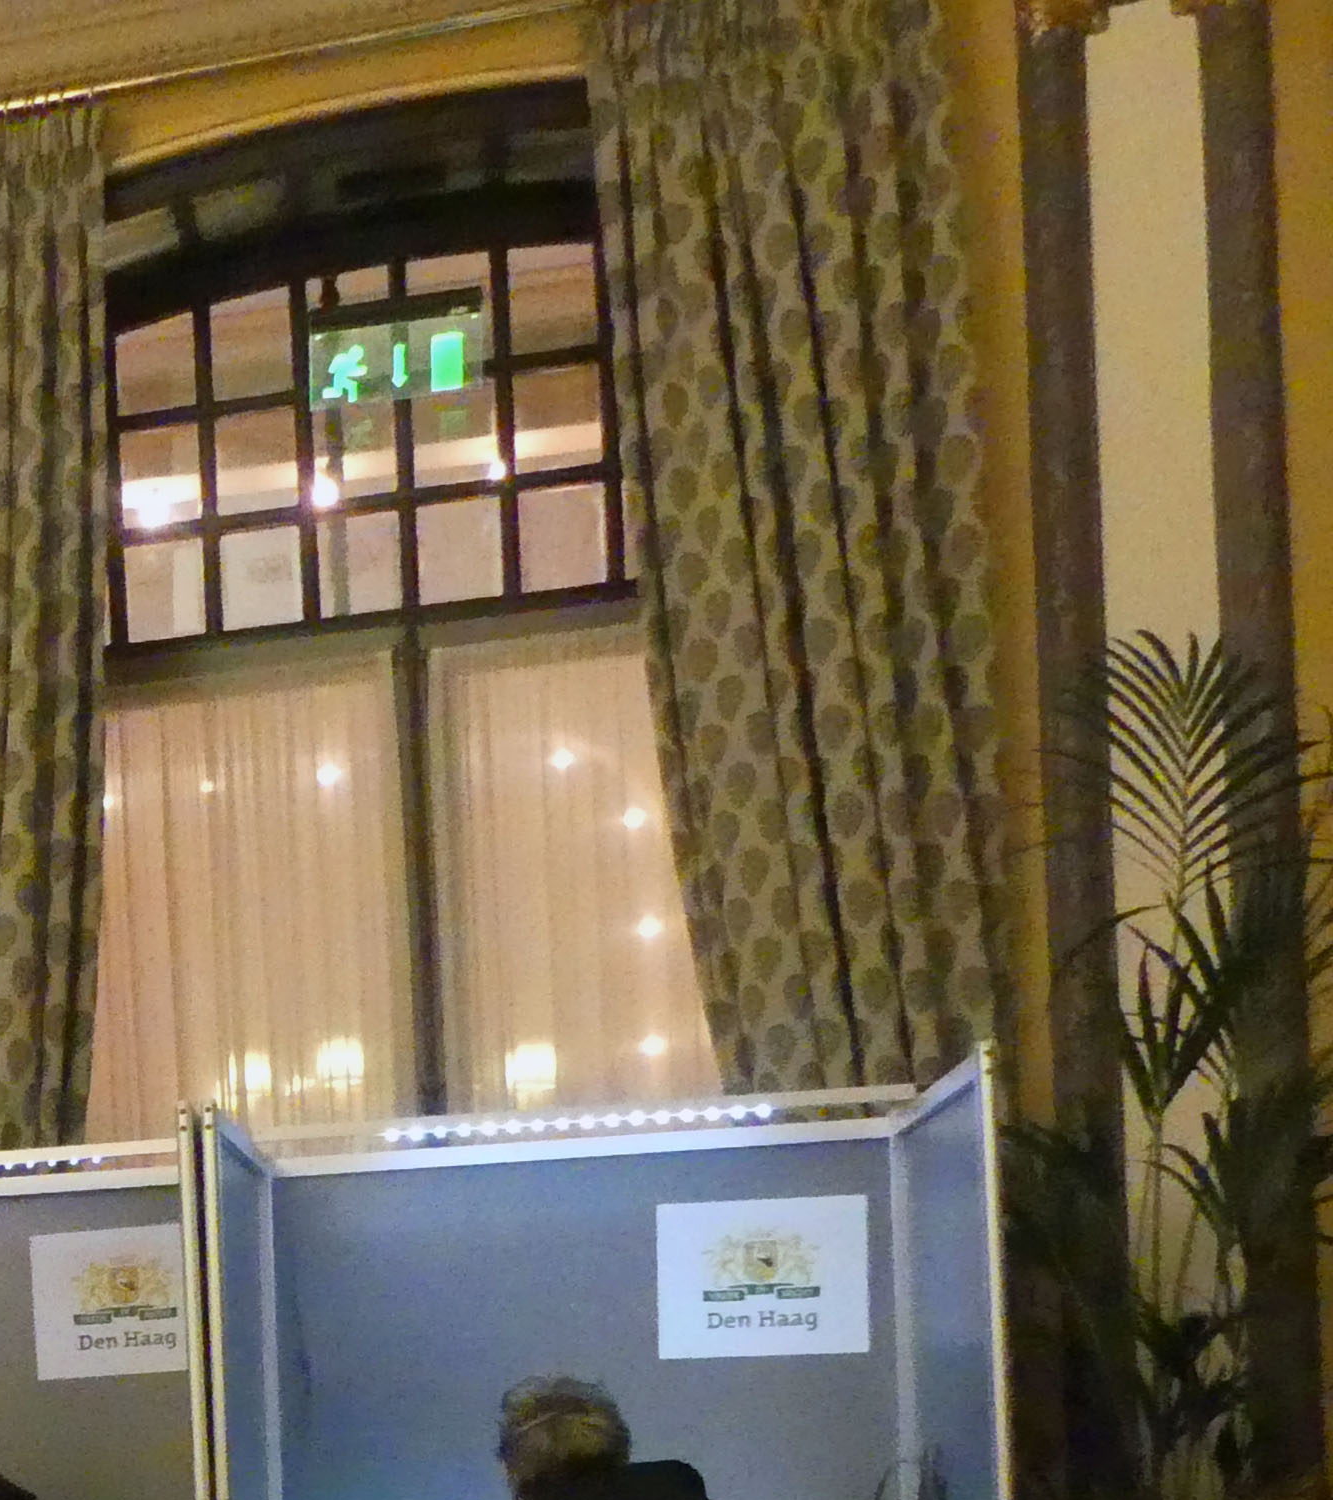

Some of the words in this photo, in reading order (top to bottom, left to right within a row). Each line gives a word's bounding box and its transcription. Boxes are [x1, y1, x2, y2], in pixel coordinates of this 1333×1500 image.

[707, 1312, 751, 1329] Den
[758, 1310, 818, 1331] Haag
[77, 1334, 118, 1350] Den
[123, 1331, 177, 1349] Haag
